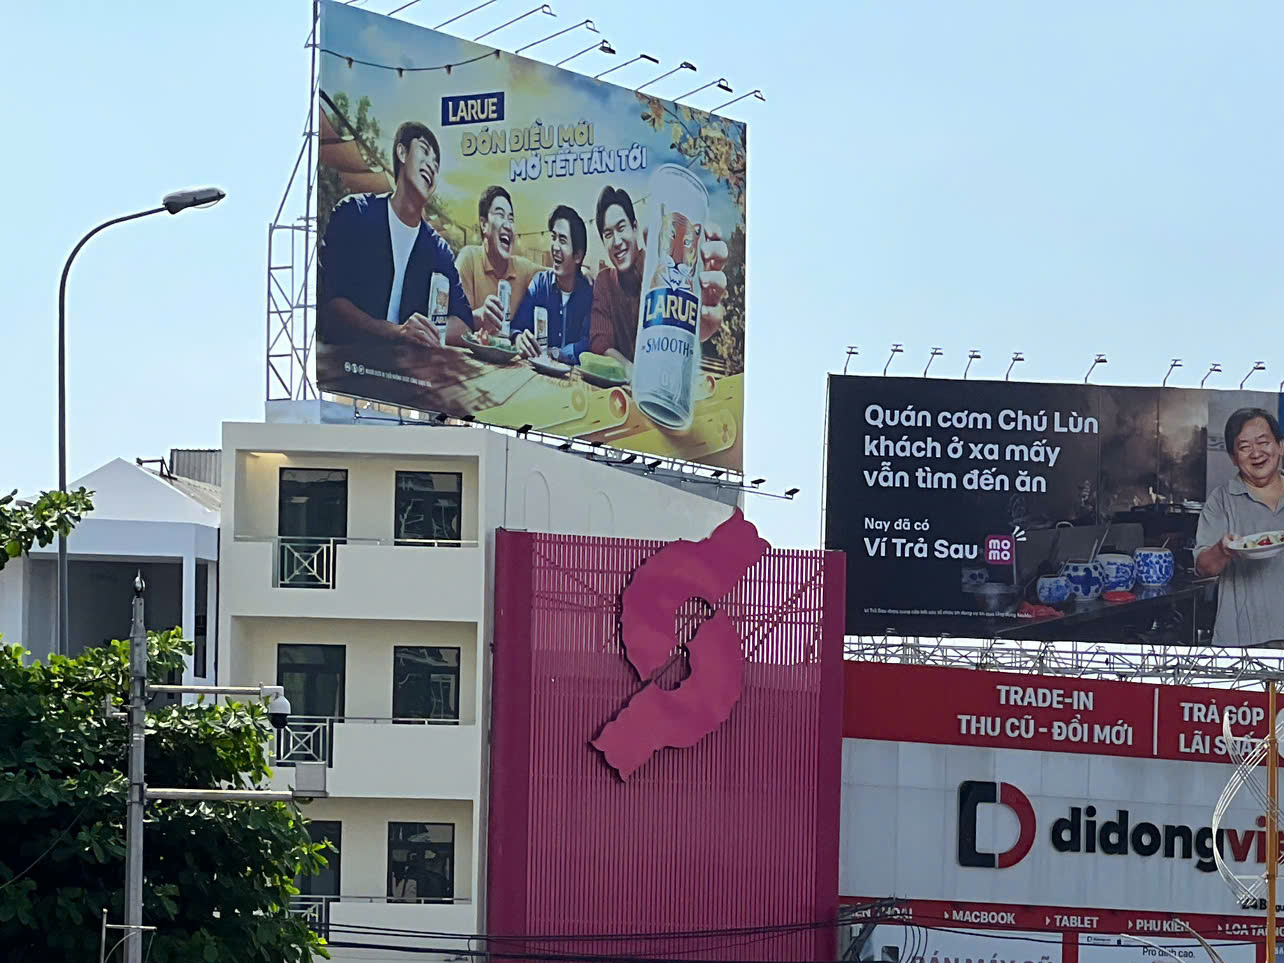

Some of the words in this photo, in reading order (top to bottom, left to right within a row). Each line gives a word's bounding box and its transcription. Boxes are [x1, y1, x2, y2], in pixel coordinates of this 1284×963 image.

[448, 97, 498, 122] LARUE
[461, 126, 507, 156] ĐÓN
[558, 120, 595, 149] MỚI
[618, 142, 647, 171] TỚI
[645, 294, 697, 326] LARUE
[645, 336, 690, 358] SMOOTH
[864, 404, 932, 429] Quán
[937, 411, 991, 429] cơm
[998, 409, 1047, 432] Chú
[1053, 411, 1099, 434] Lùn
[864, 435, 941, 458] khách
[947, 436, 963, 459] ở
[968, 443, 999, 460] xa
[1005, 439, 1061, 467] mấy
[863, 461, 909, 488] vẫn
[915, 466, 957, 489] tìm
[962, 467, 1009, 491] đến
[1015, 470, 1047, 493] ăn
[864, 517, 891, 532] Nay
[893, 518, 911, 530] đã
[914, 519, 930, 531] có
[863, 537, 888, 557] Ví
[891, 537, 928, 558] Trả
[934, 539, 978, 559] Sau
[988, 539, 1011, 549] mo
[988, 550, 1011, 561] mo
[996, 684, 1094, 711] TRADE-IN
[1179, 699, 1220, 724] TRẢ
[1224, 701, 1265, 726] GÓP
[957, 714, 1000, 736] THU
[1005, 714, 1034, 738] CŨ
[1051, 713, 1091, 742] ĐỔI
[1094, 721, 1133, 746] MỚI
[1179, 730, 1210, 754] LÃI
[952, 910, 1015, 924] MACBOOK
[1053, 915, 1099, 928] TABLET
[1225, 923, 1249, 935] LOA
[1142, 947, 1157, 956] Pro
